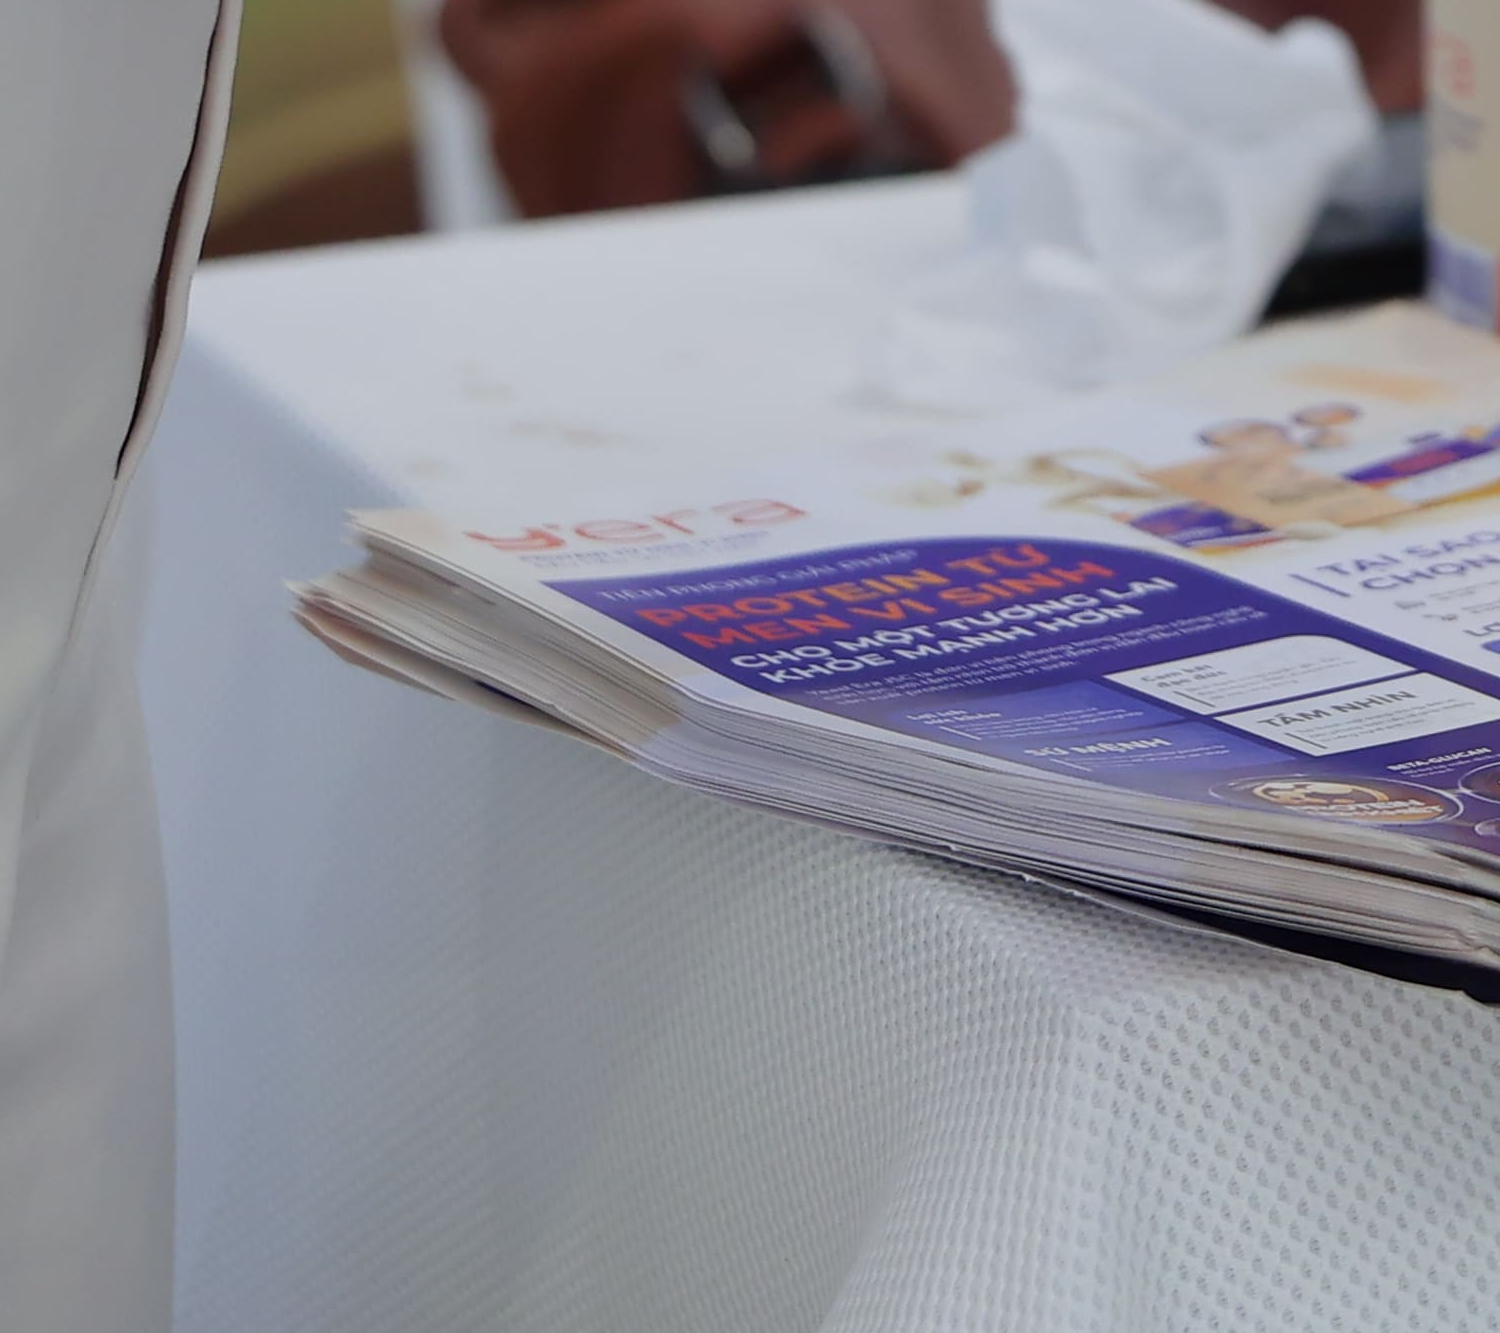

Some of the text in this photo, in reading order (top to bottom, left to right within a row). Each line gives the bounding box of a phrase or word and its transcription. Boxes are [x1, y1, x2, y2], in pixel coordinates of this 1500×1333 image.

[636, 568, 951, 628] PROTEIN
[680, 562, 1118, 649] MEN VI SINH
[730, 577, 1178, 670] CHO MỘT TƯƠNG LAI
[757, 601, 1143, 685] KHỎE MẠNH HƠN
[1333, 689, 1419, 713] NHÌN
[1387, 747, 1493, 771] BETA-GLUCAN
